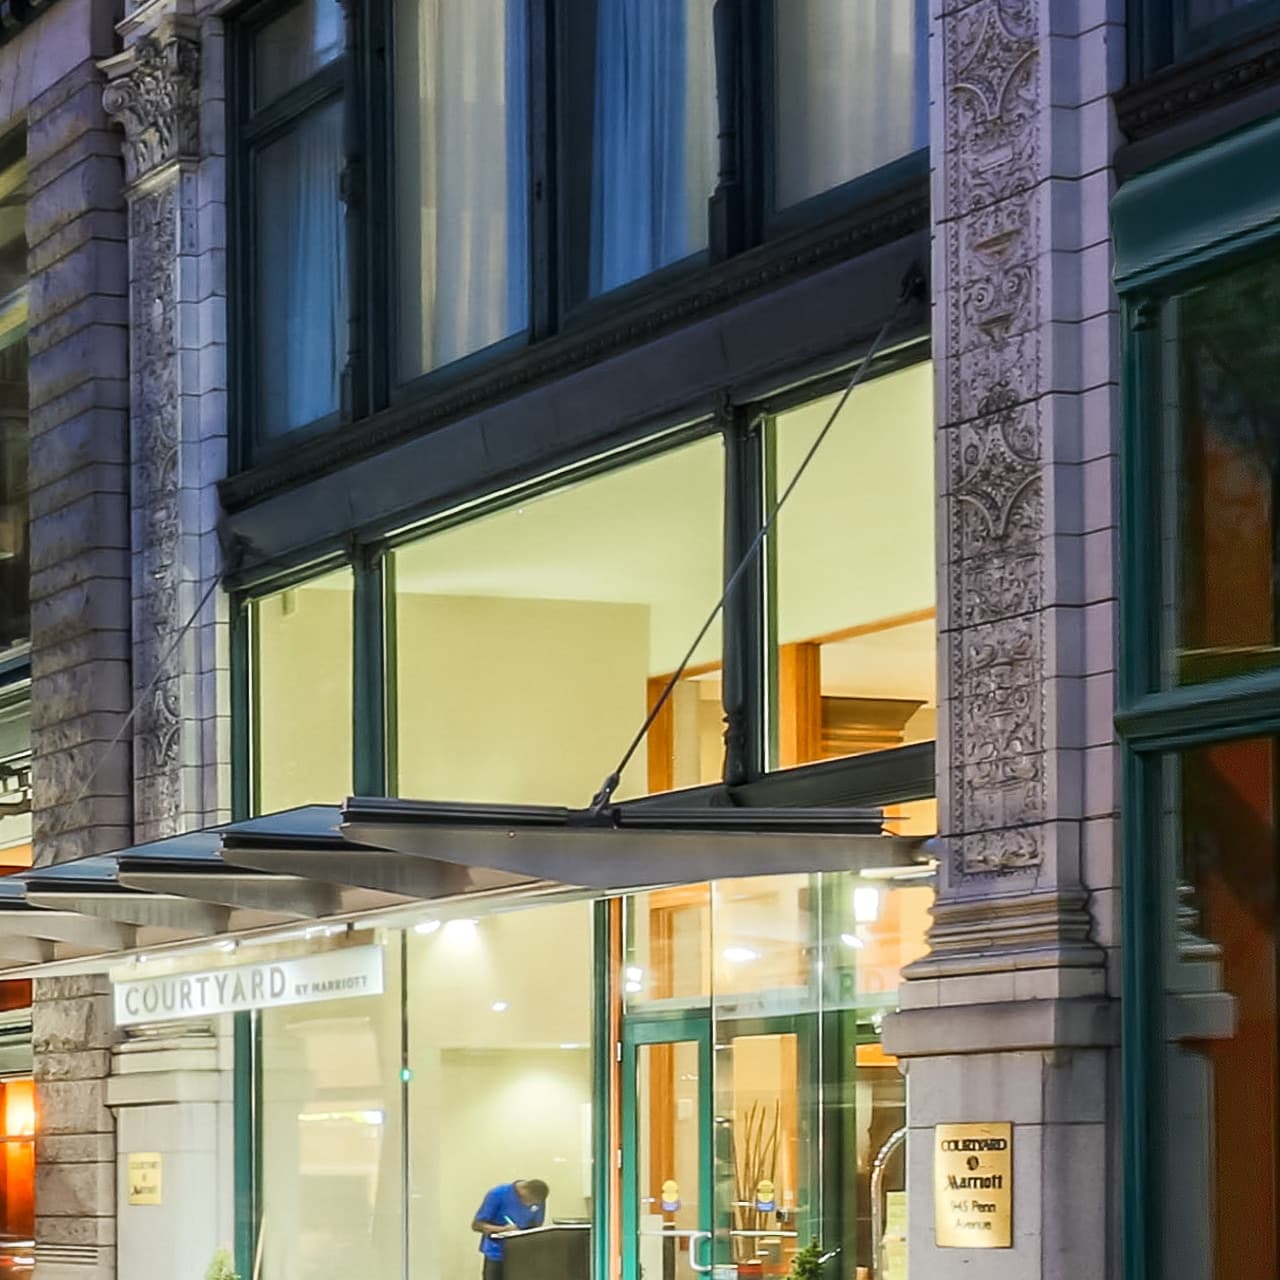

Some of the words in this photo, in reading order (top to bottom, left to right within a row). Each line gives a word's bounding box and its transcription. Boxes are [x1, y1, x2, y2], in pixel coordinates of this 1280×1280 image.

[125, 966, 287, 1016] COURTYARD
[295, 984, 309, 996] BY
[311, 975, 368, 995] MARRIOTT
[946, 1174, 1003, 1190] Marriott
[971, 1200, 996, 1213] Penn
